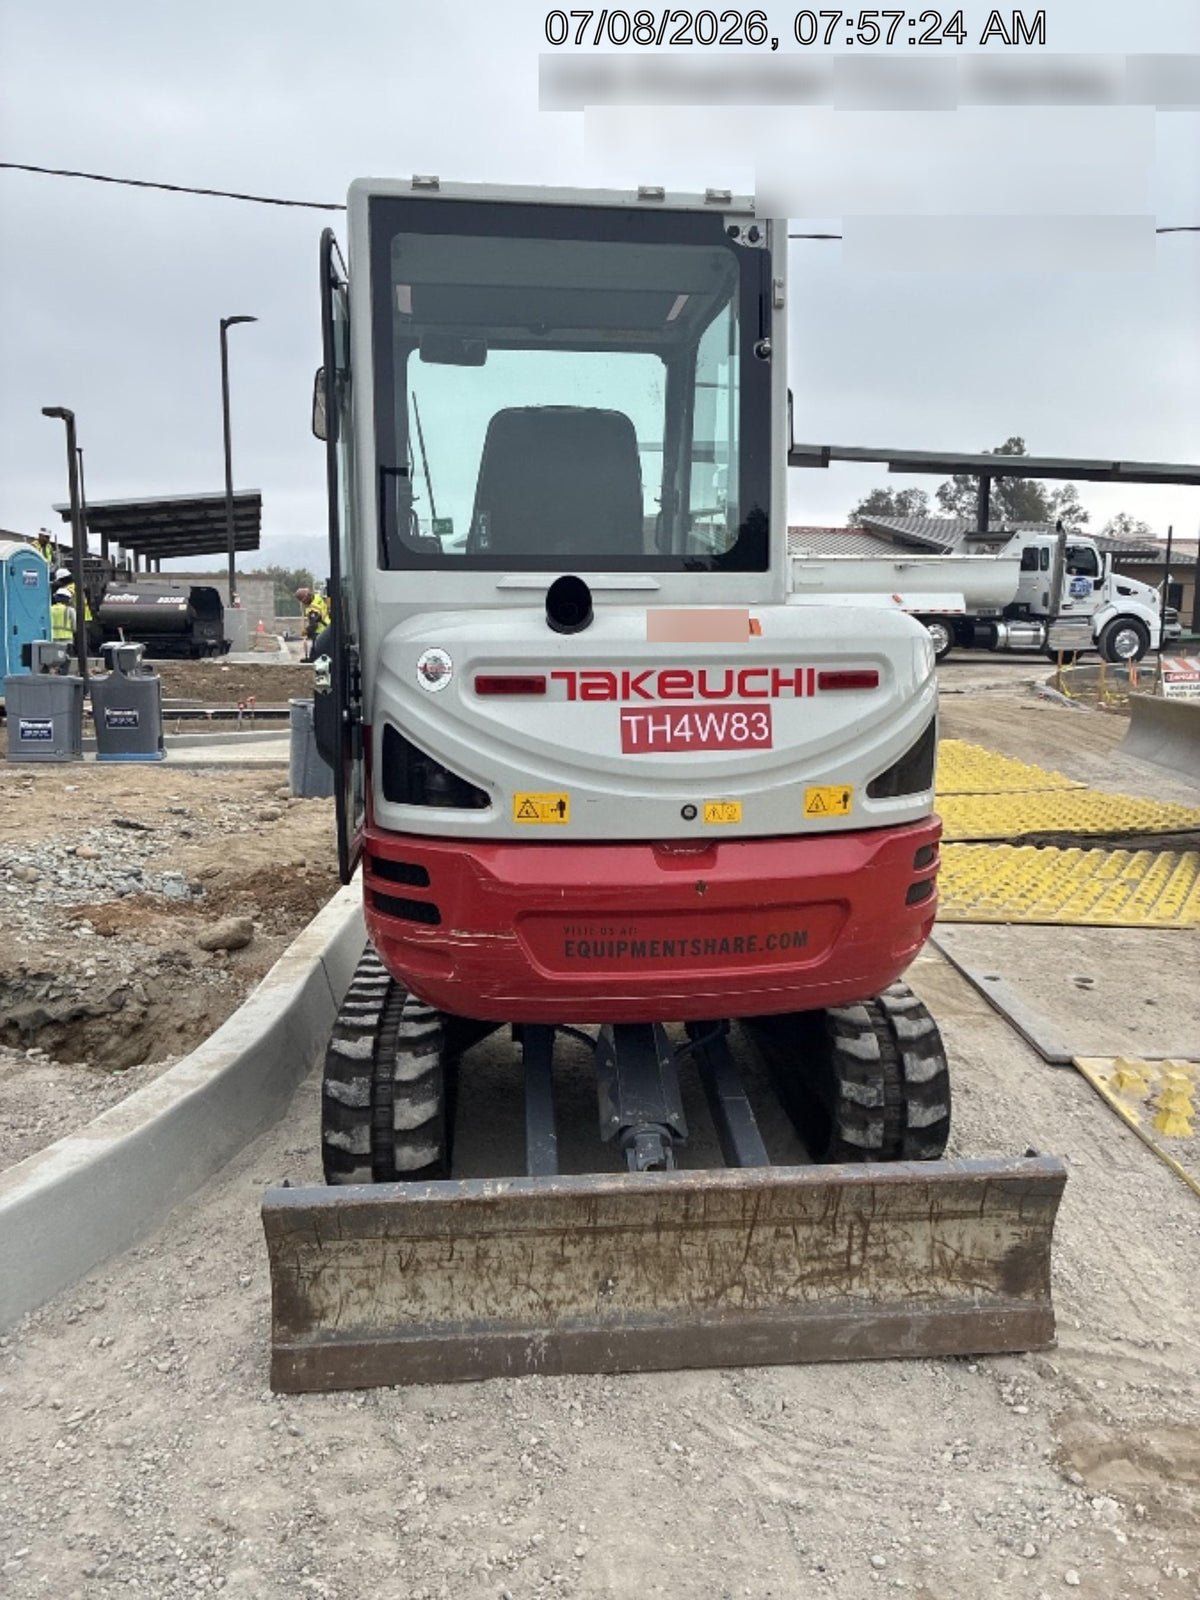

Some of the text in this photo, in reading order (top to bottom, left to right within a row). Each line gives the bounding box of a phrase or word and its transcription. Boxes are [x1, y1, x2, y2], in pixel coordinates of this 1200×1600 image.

[551, 668, 815, 700] TAKEUCHI
[622, 711, 769, 744] TH4W83
[564, 929, 809, 959] EQUIPMENTSHARE.COM
[600, 927, 615, 936] US
